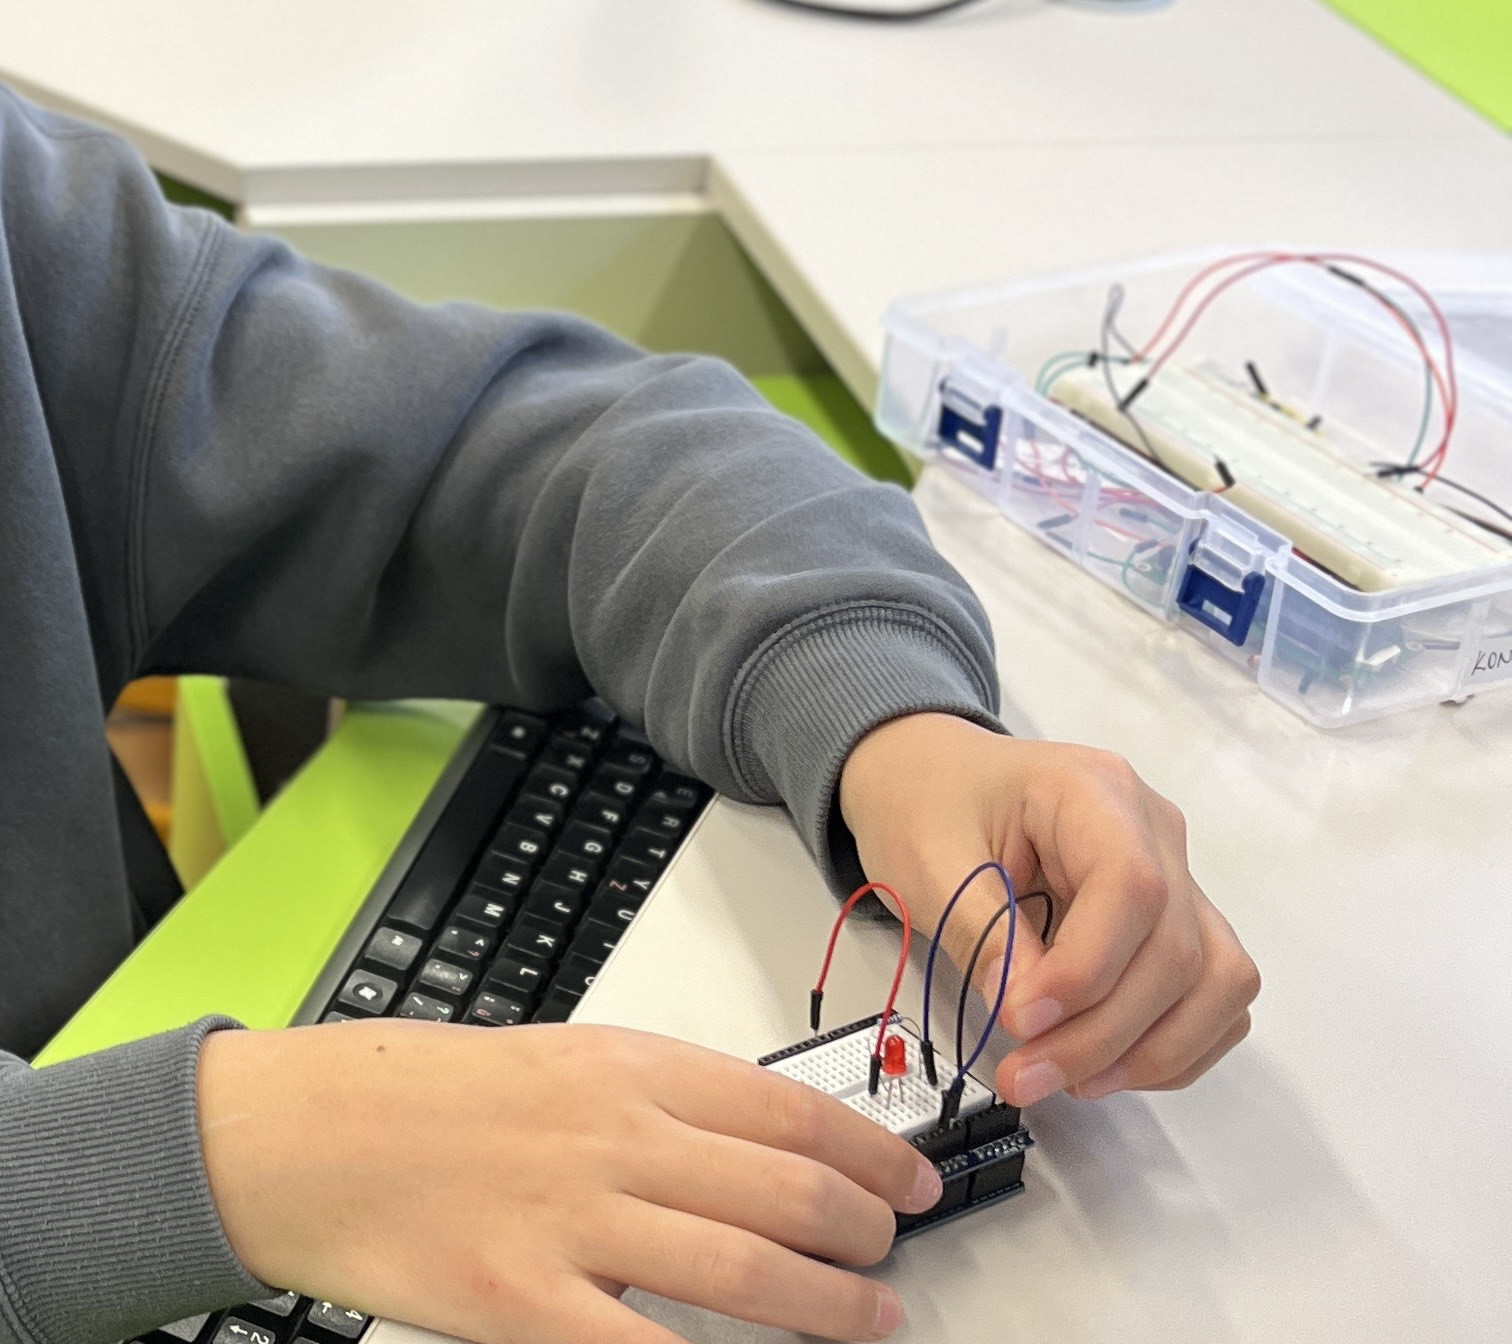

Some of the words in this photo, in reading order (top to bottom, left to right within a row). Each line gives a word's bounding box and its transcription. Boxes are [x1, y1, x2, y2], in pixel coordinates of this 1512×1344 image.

[549, 783, 569, 796] C
[615, 782, 634, 795] D
[535, 813, 555, 826] V
[602, 810, 620, 822] F
[662, 816, 681, 828] R
[519, 841, 539, 853] B
[584, 840, 604, 854] G
[648, 847, 666, 859] T
[501, 872, 522, 886] N
[568, 870, 588, 883] H
[633, 879, 652, 890] Y
[483, 903, 504, 918] M
[554, 901, 572, 913] J
[536, 934, 556, 948] K
[519, 967, 539, 977] L
[345, 1309, 363, 1321] 4
